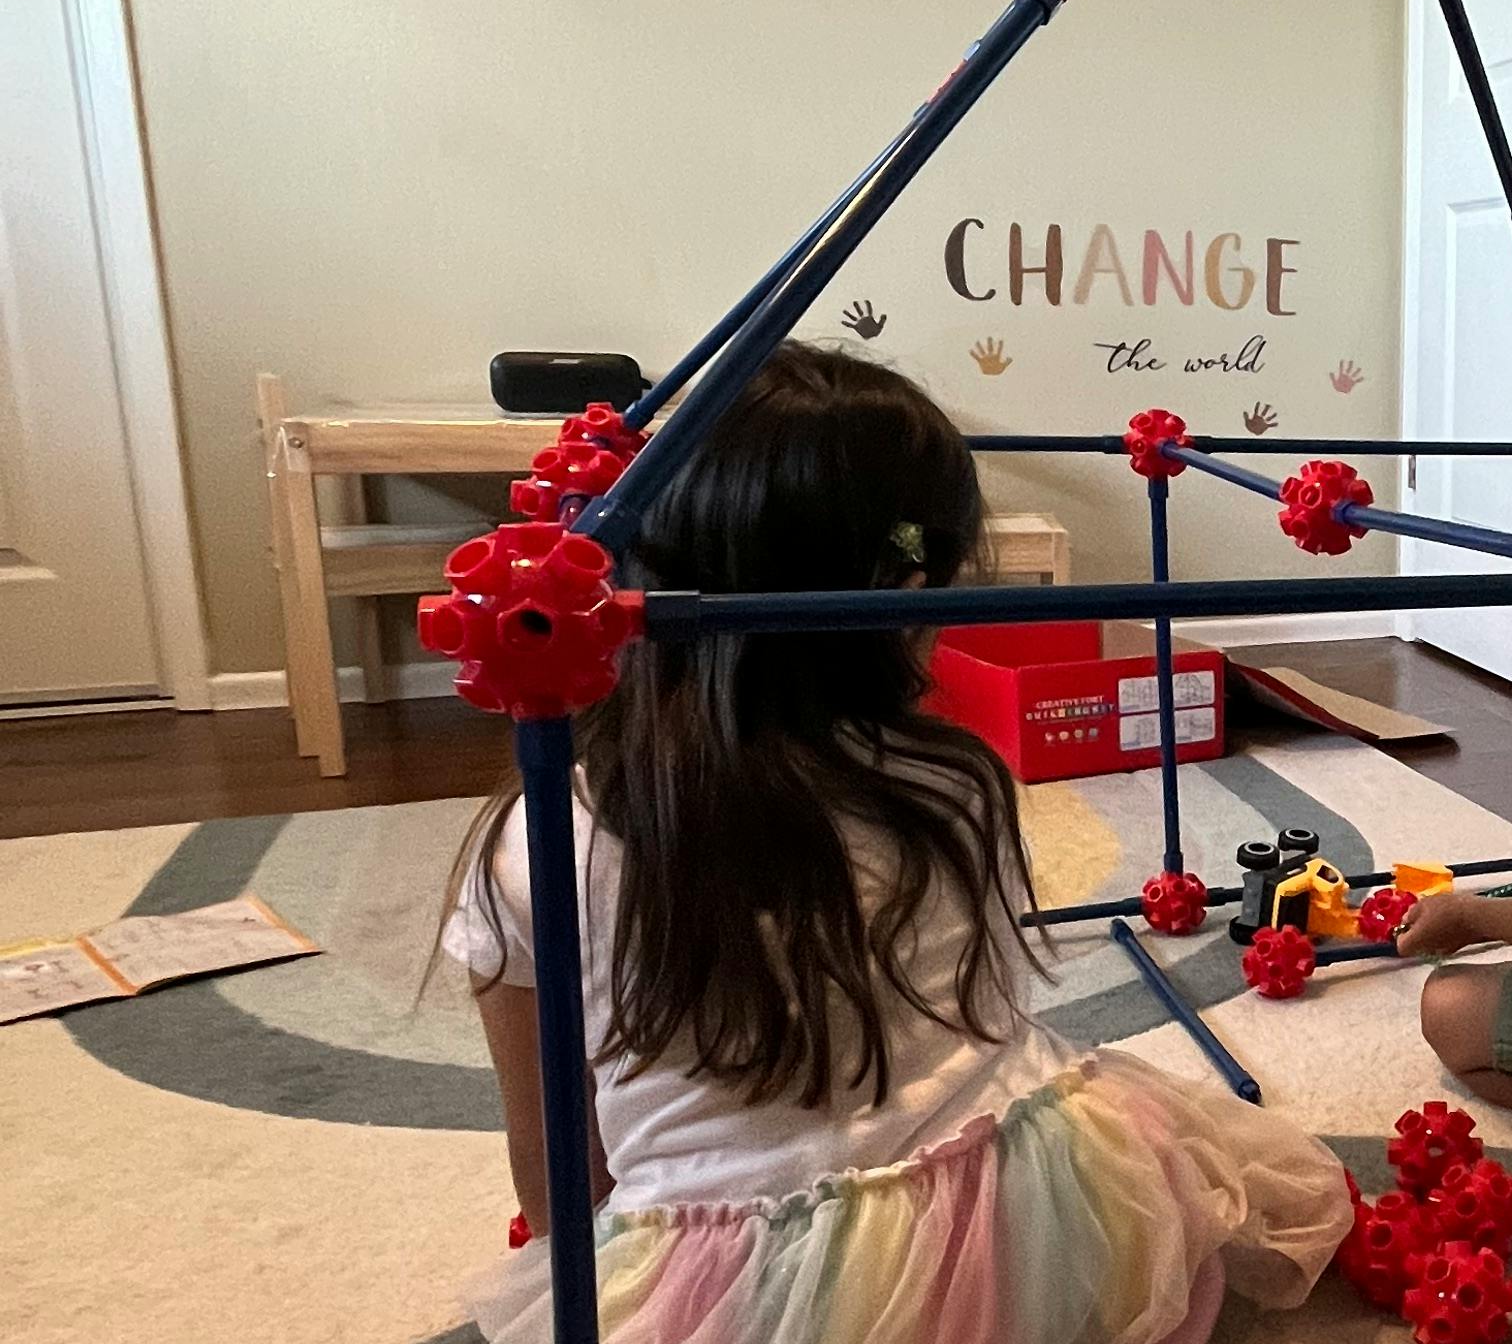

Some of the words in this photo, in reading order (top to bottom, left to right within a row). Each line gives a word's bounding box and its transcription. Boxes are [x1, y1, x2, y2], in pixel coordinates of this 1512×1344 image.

[945, 217, 1301, 316] CHANGE
[1094, 336, 1168, 374] the
[1184, 334, 1267, 374] world
